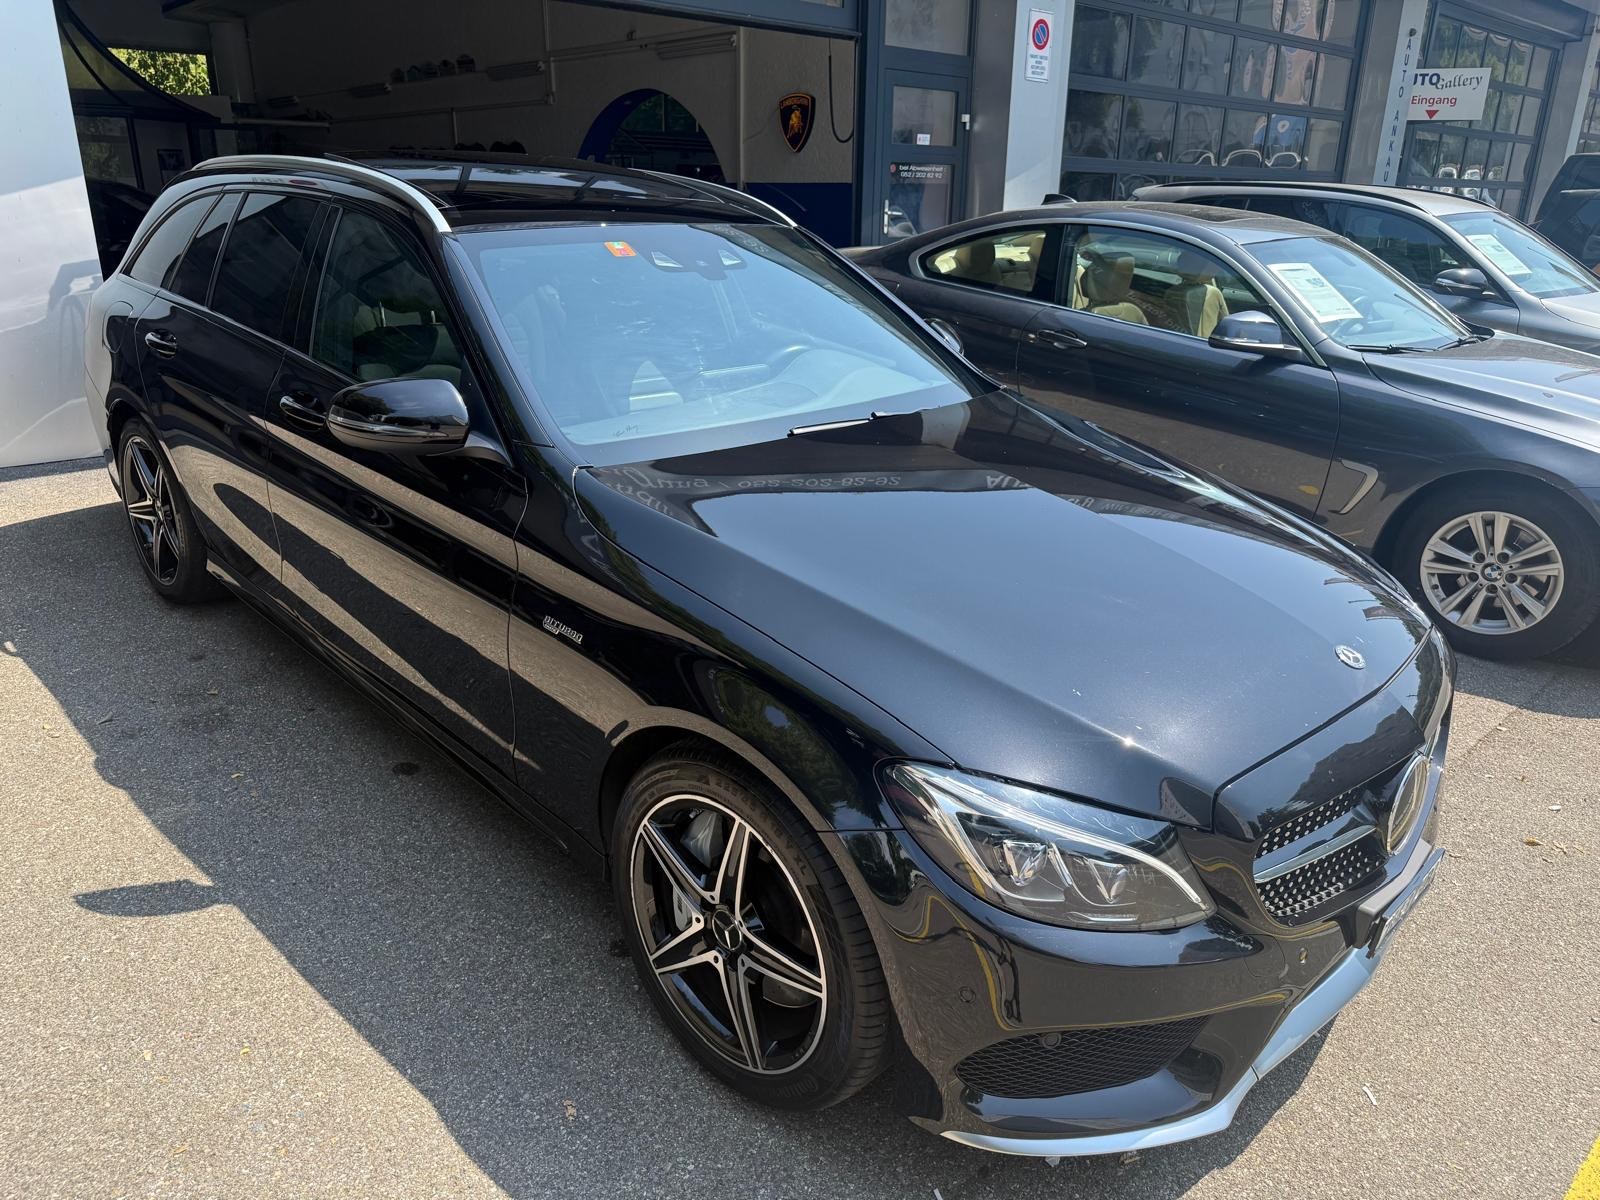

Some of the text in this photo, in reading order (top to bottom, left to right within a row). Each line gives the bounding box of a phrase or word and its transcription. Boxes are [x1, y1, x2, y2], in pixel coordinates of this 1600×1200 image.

[1435, 73, 1483, 90] Gallery
[1411, 95, 1457, 107] Eingang
[1383, 38, 1412, 183] AUTO ANKAU
